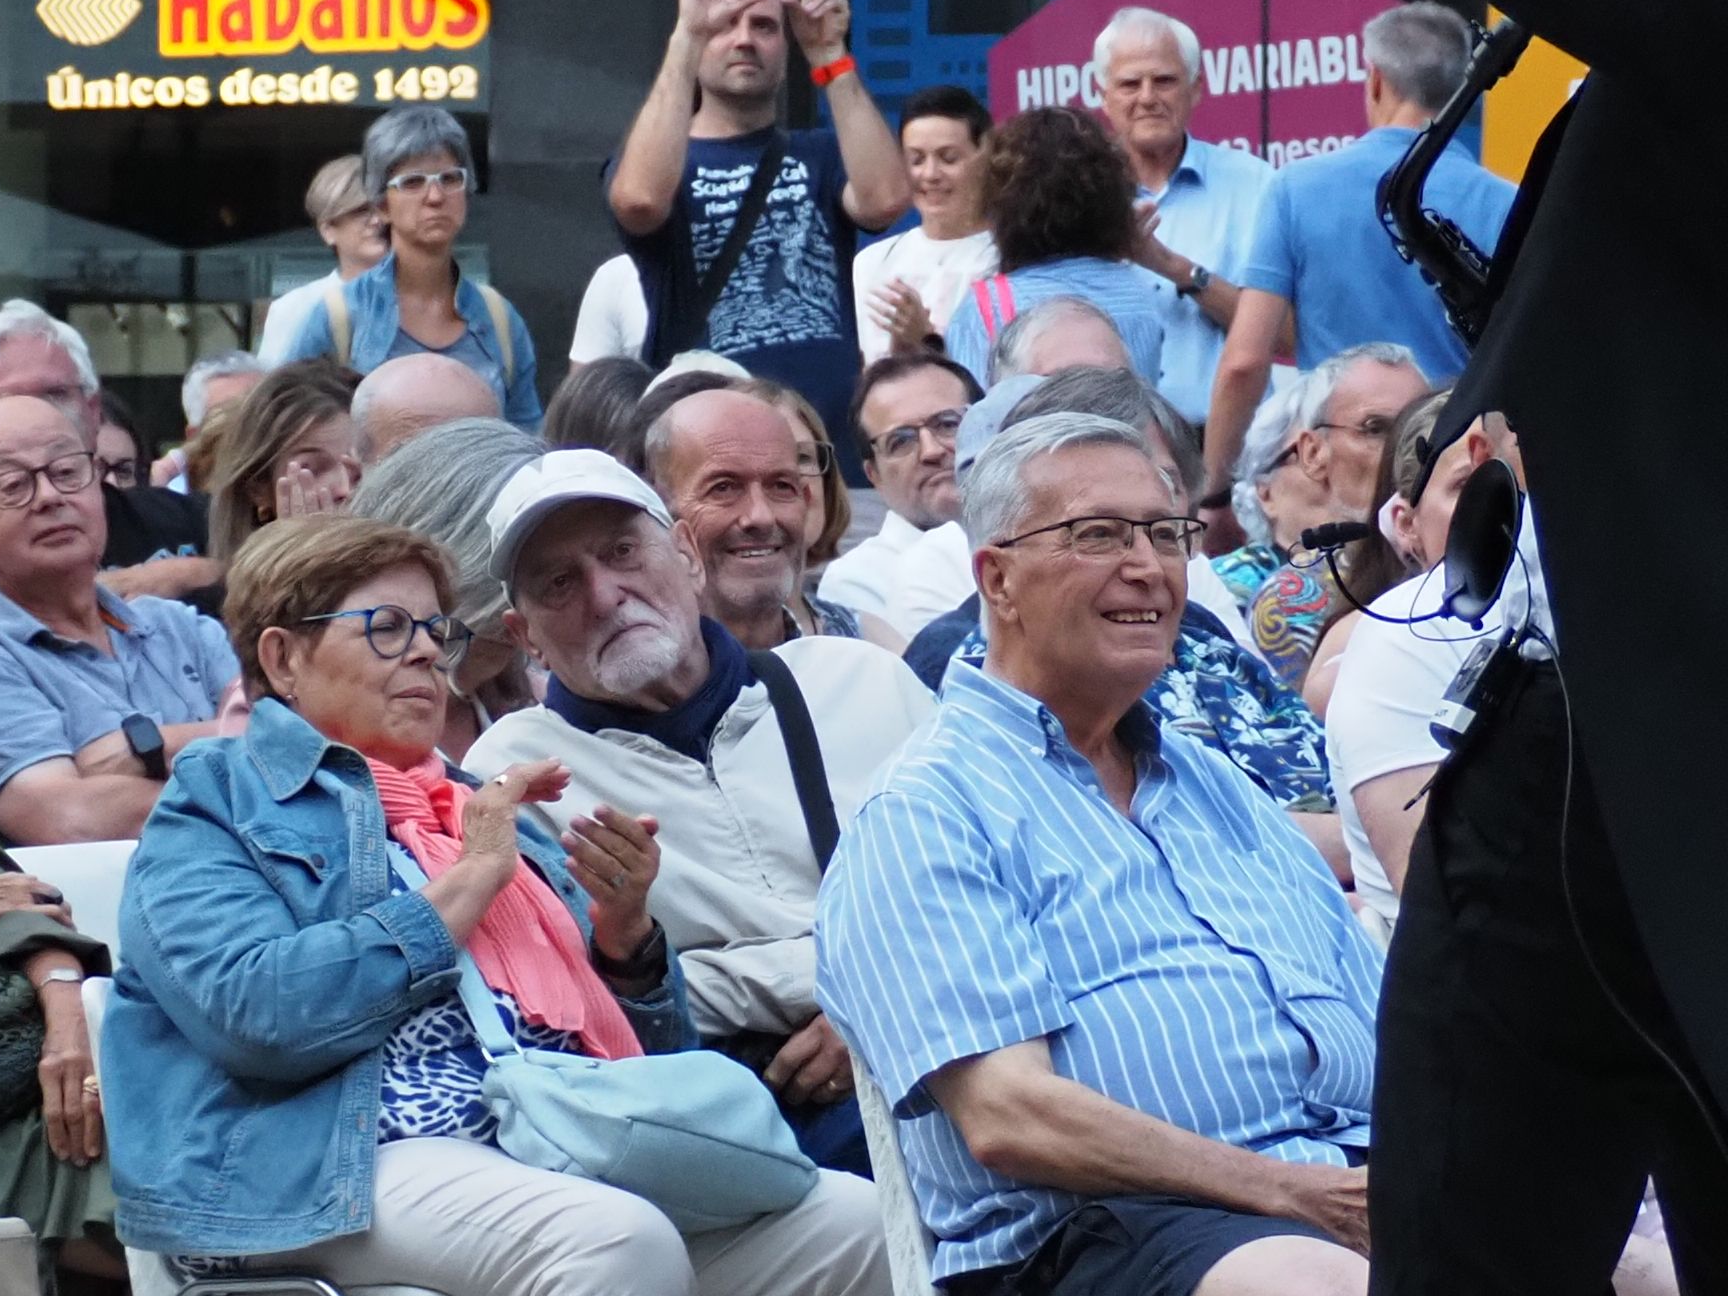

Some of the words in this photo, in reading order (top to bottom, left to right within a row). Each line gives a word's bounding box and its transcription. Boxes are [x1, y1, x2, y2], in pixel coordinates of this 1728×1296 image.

[46, 64, 211, 110] Únicos
[219, 65, 359, 106] desde
[374, 63, 479, 101] 1492
[1201, 34, 1369, 97] VARIABL
